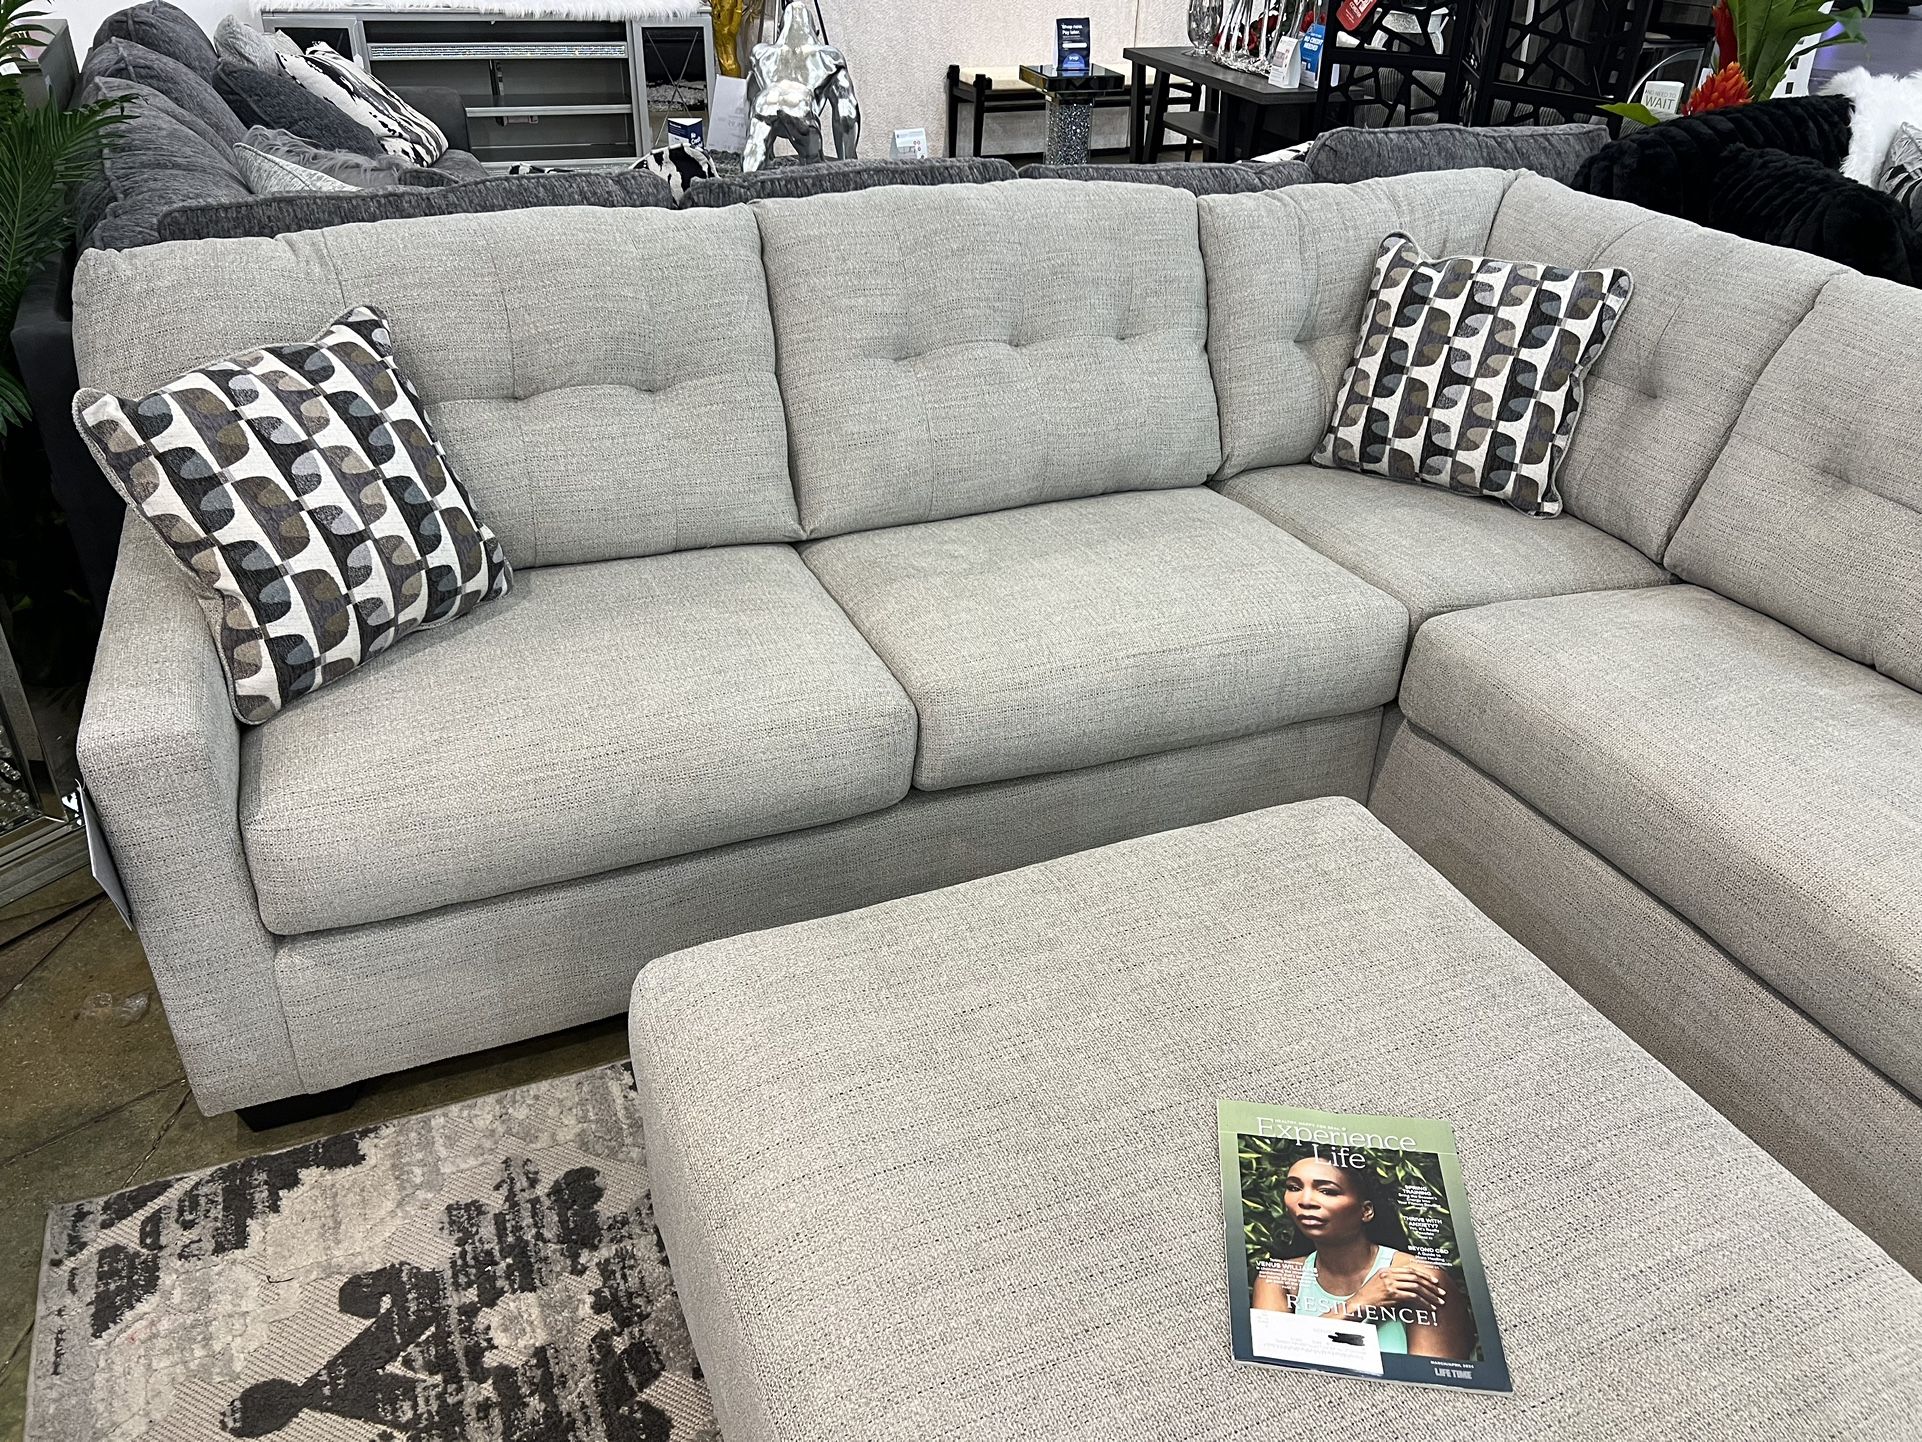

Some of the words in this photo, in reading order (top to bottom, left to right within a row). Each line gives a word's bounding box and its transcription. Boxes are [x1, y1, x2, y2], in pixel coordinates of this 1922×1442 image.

[1645, 95, 1676, 110] WAIT
[1256, 1117, 1417, 1153] Experience
[1312, 1143, 1366, 1169] Life
[1407, 1245, 1434, 1253] BEYOND
[1255, 1260, 1281, 1268] VENUS
[1286, 1293, 1438, 1327] RESILIENCE!
[1434, 1367, 1451, 1378] LIFE
[1451, 1369, 1472, 1379] TIME
